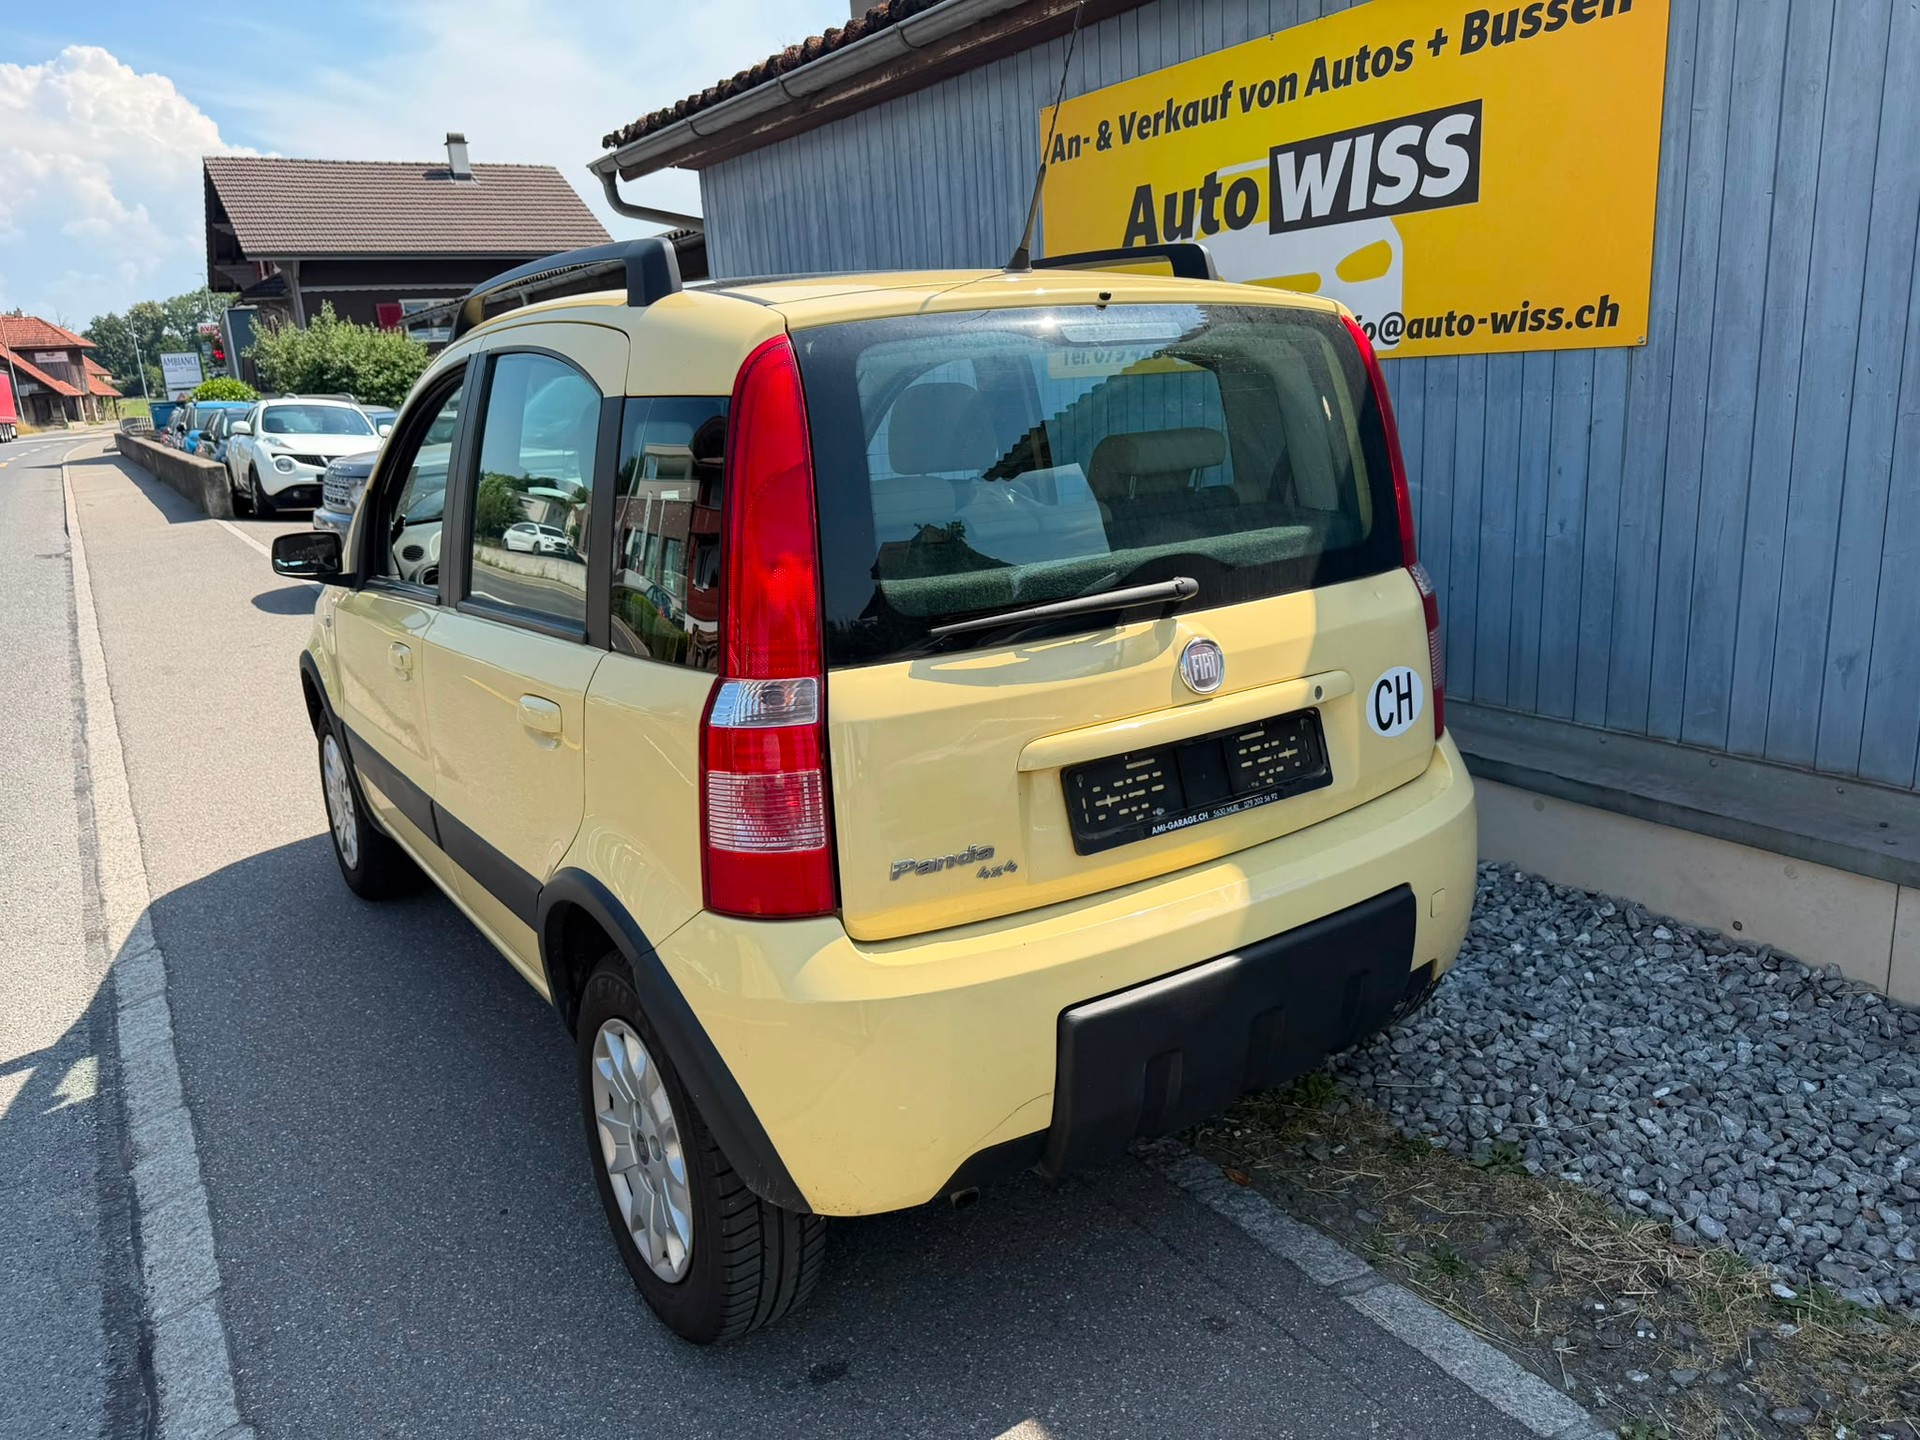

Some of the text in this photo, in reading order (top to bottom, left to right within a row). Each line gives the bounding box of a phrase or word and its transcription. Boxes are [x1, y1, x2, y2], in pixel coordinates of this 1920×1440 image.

[1050, 133, 1090, 165] An-
[1095, 120, 1113, 151] &
[1119, 79, 1234, 145] Verkauf
[1239, 72, 1299, 113] von
[1304, 39, 1414, 97] Autos
[1426, 27, 1448, 58] +
[1122, 113, 1476, 249] Auto WISS
[162, 356, 198, 367] AMBIANCE
[1191, 652, 1217, 682] FIAT
[1375, 671, 1414, 731] CH
[1152, 811, 1209, 835] AMI-GARAGE.CH
[890, 844, 995, 880] Panda
[976, 860, 1018, 879] 4x4
